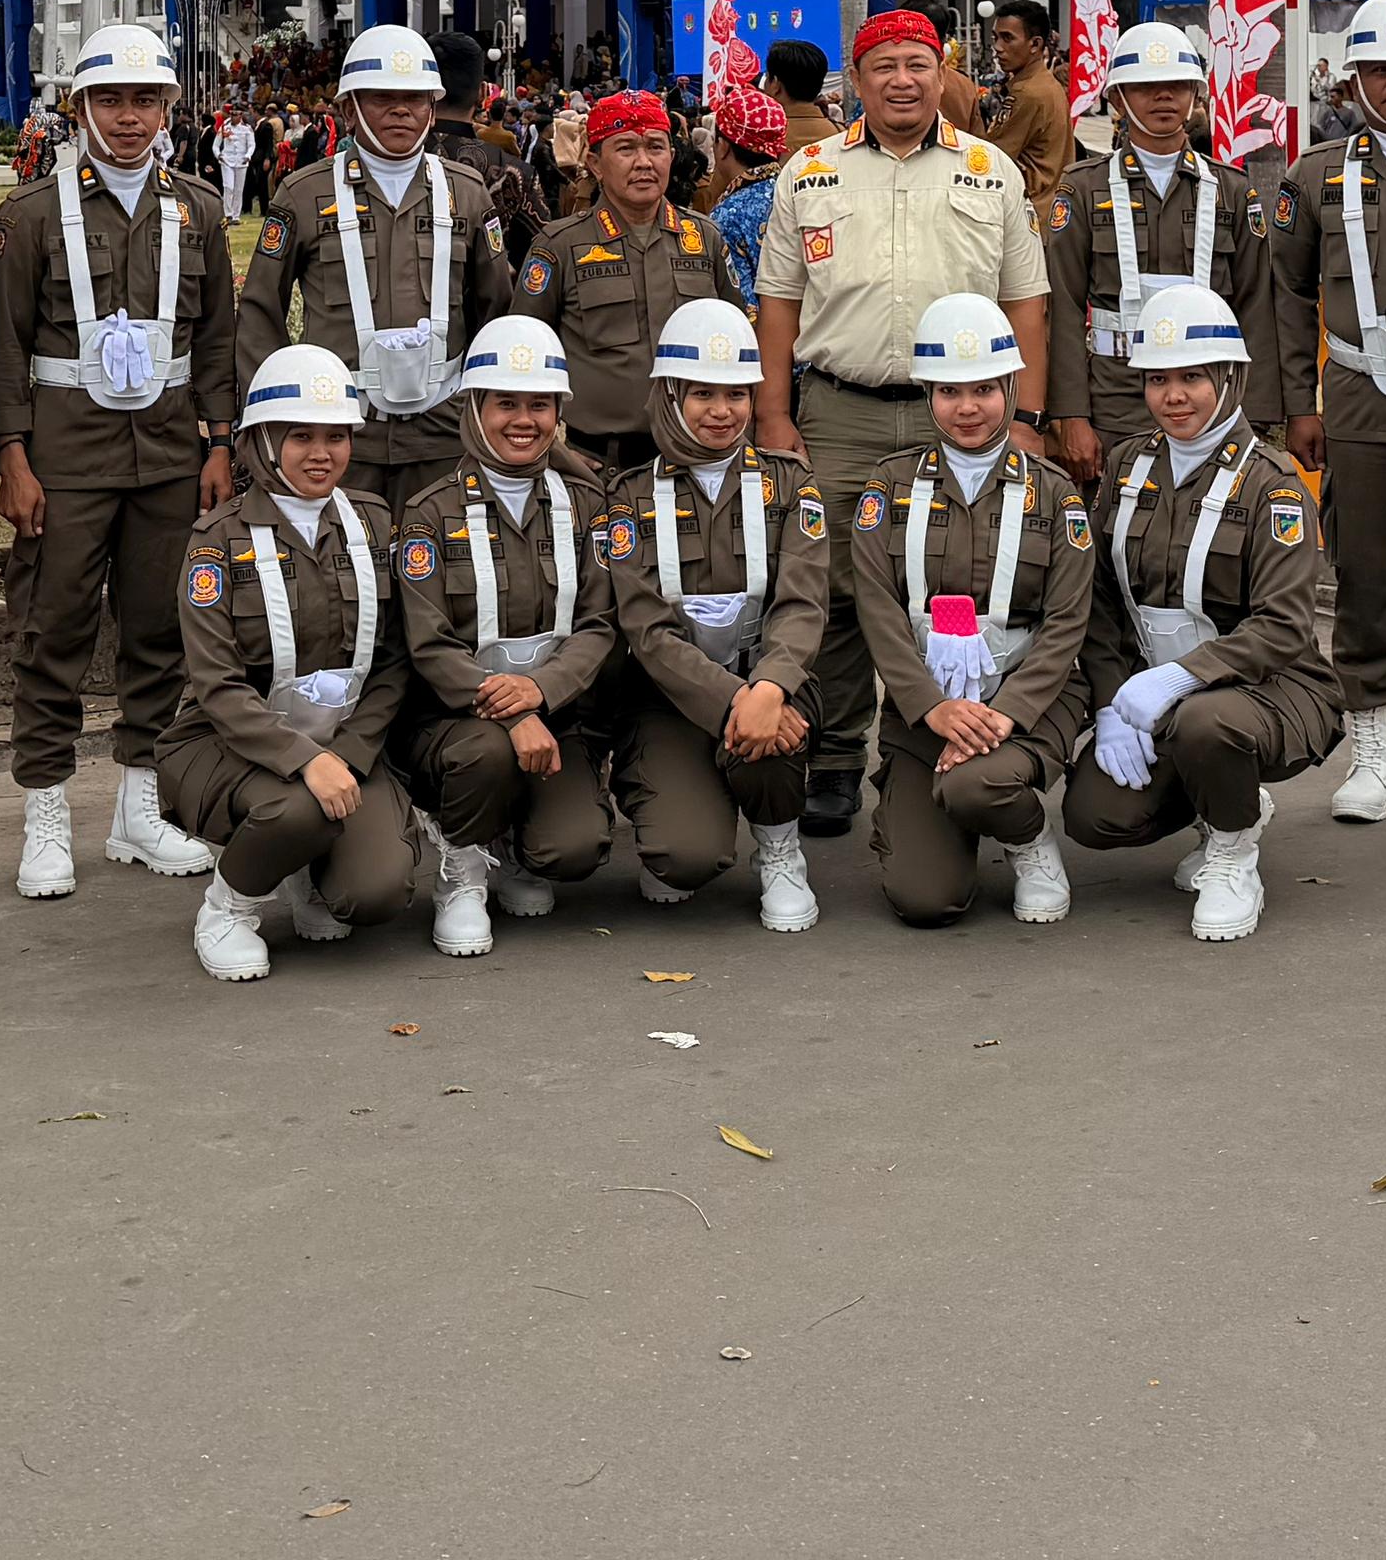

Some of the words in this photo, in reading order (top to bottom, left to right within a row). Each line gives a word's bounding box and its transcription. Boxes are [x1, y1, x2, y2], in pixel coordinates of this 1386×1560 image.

[793, 174, 839, 194] IRVAN
[954, 174, 981, 189] POL
[987, 179, 1004, 190] PP
[675, 260, 700, 271] POL
[581, 265, 624, 279] ZUBAIR
[1226, 508, 1243, 518] PP
[1029, 519, 1048, 530] PP
